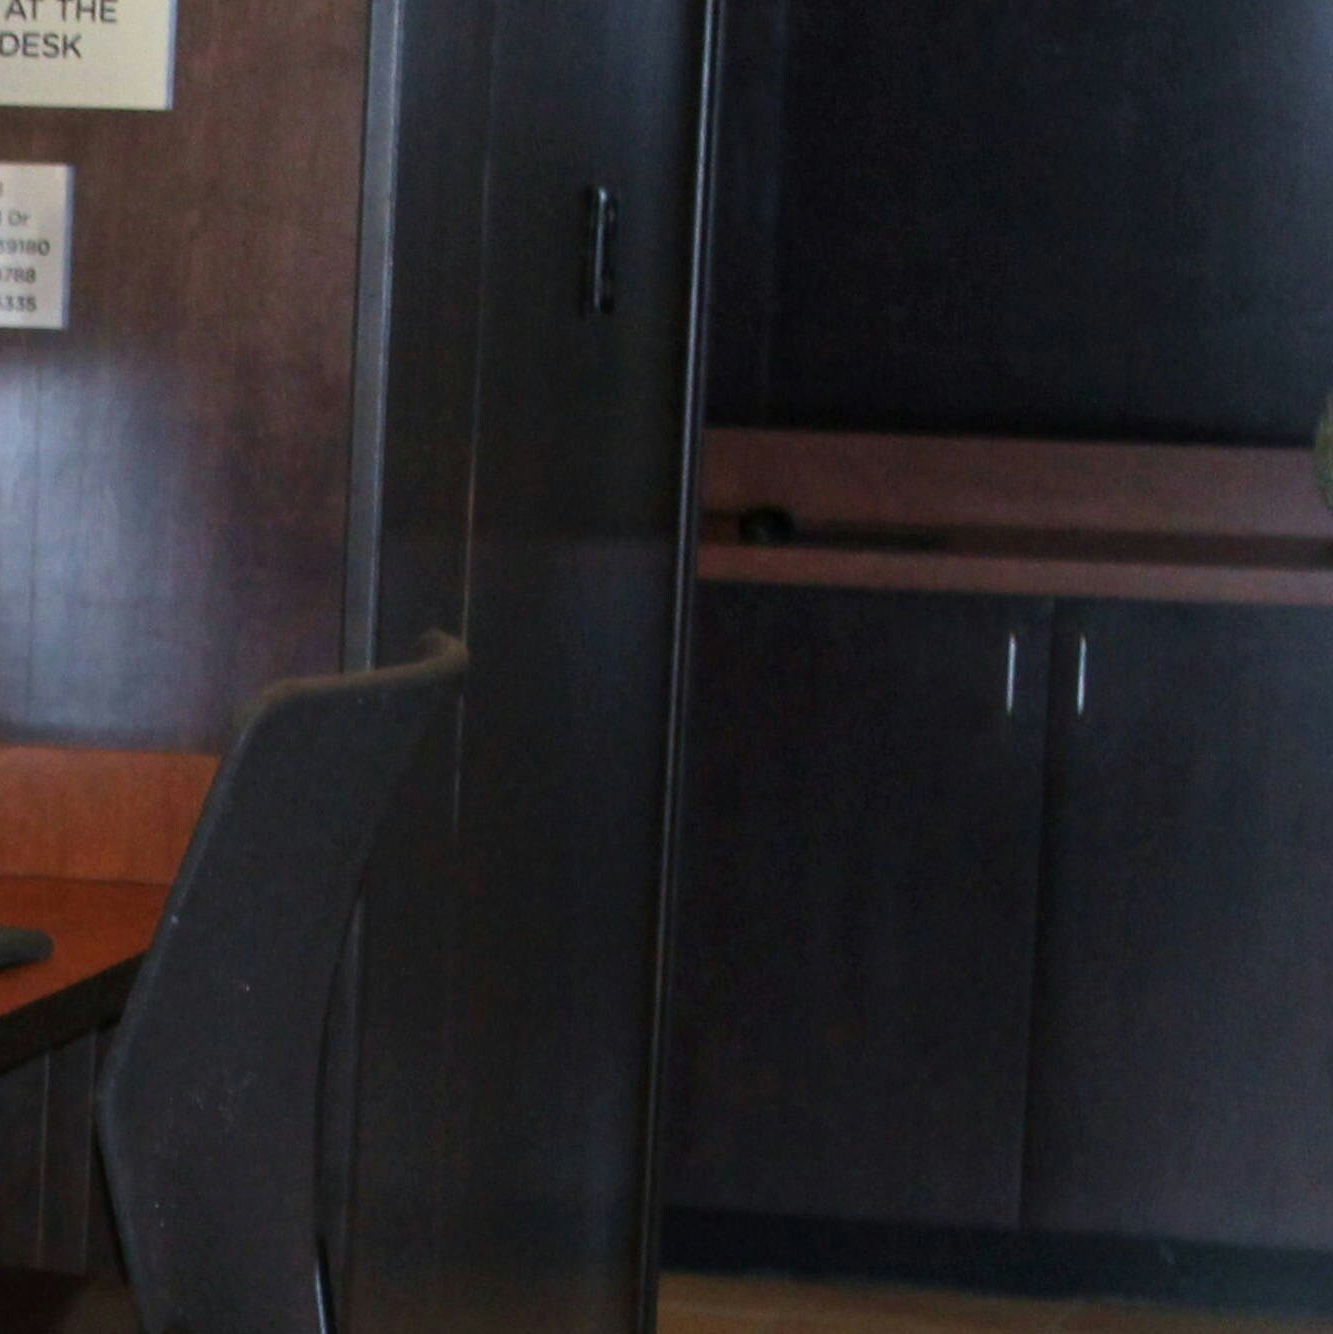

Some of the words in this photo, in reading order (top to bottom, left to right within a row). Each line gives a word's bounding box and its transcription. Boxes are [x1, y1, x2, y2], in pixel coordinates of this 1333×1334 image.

[4, 0, 42, 20] AT
[57, 0, 118, 23] THE
[7, 208, 31, 227] Dr
